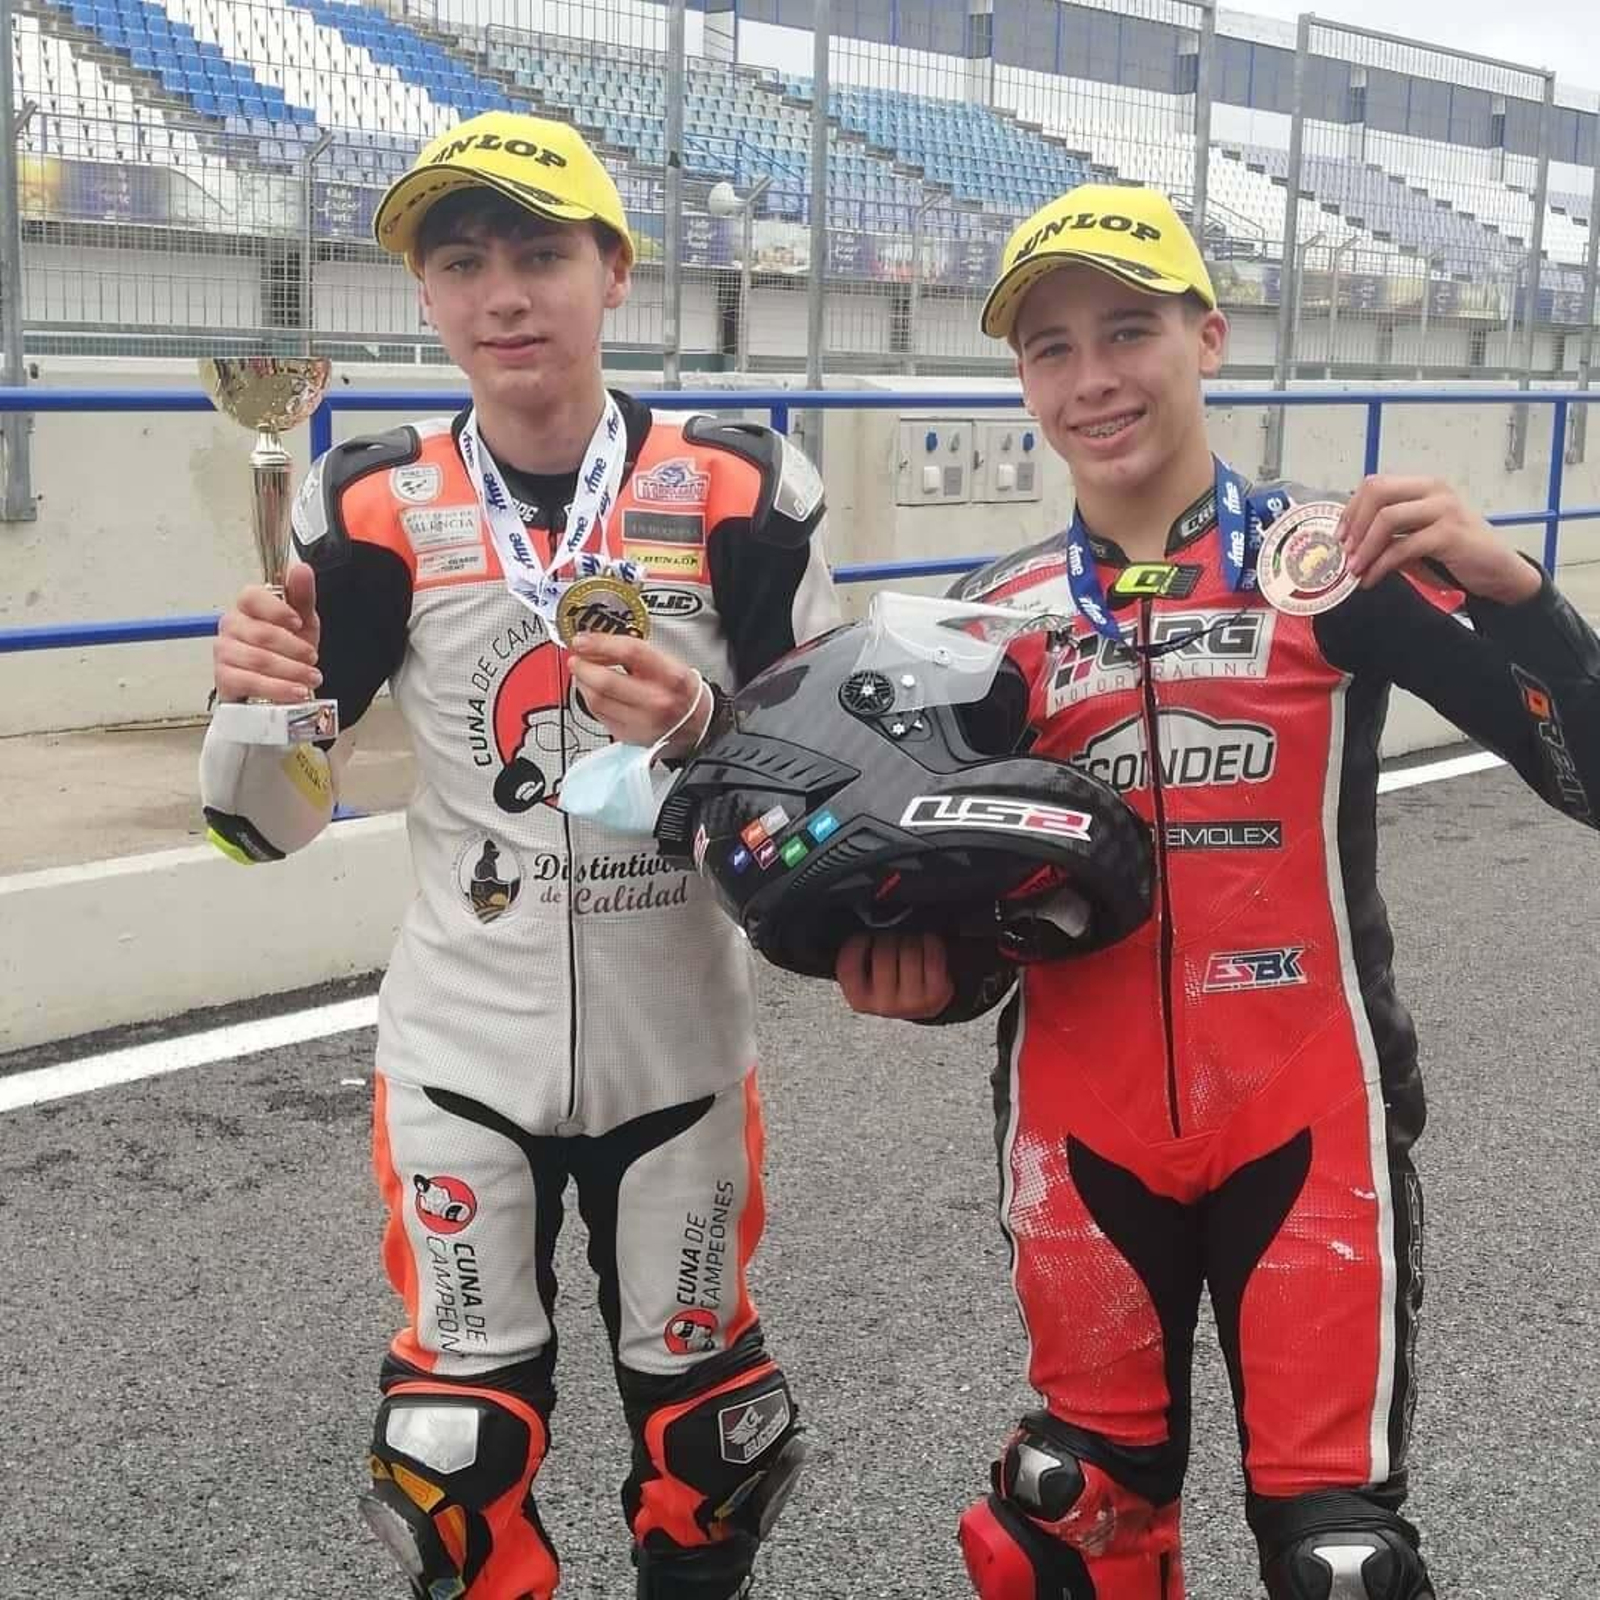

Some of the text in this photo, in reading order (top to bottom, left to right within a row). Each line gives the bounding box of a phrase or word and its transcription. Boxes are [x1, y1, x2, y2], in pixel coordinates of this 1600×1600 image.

[430, 134, 567, 168] UNLOP
[641, 595, 693, 610] HJC
[471, 658, 498, 693] DE
[1151, 661, 1258, 682] RACING
[467, 697, 492, 767] CUNA
[899, 796, 1093, 842] LS2
[540, 876, 688, 916] de Calidad
[1204, 947, 1307, 985] ESBK
[676, 1212, 707, 1306] CUNA DE
[700, 1179, 734, 1310] CAMPEONES
[427, 1235, 462, 1354] CAMPEON
[454, 1242, 488, 1345] CUNA DE
